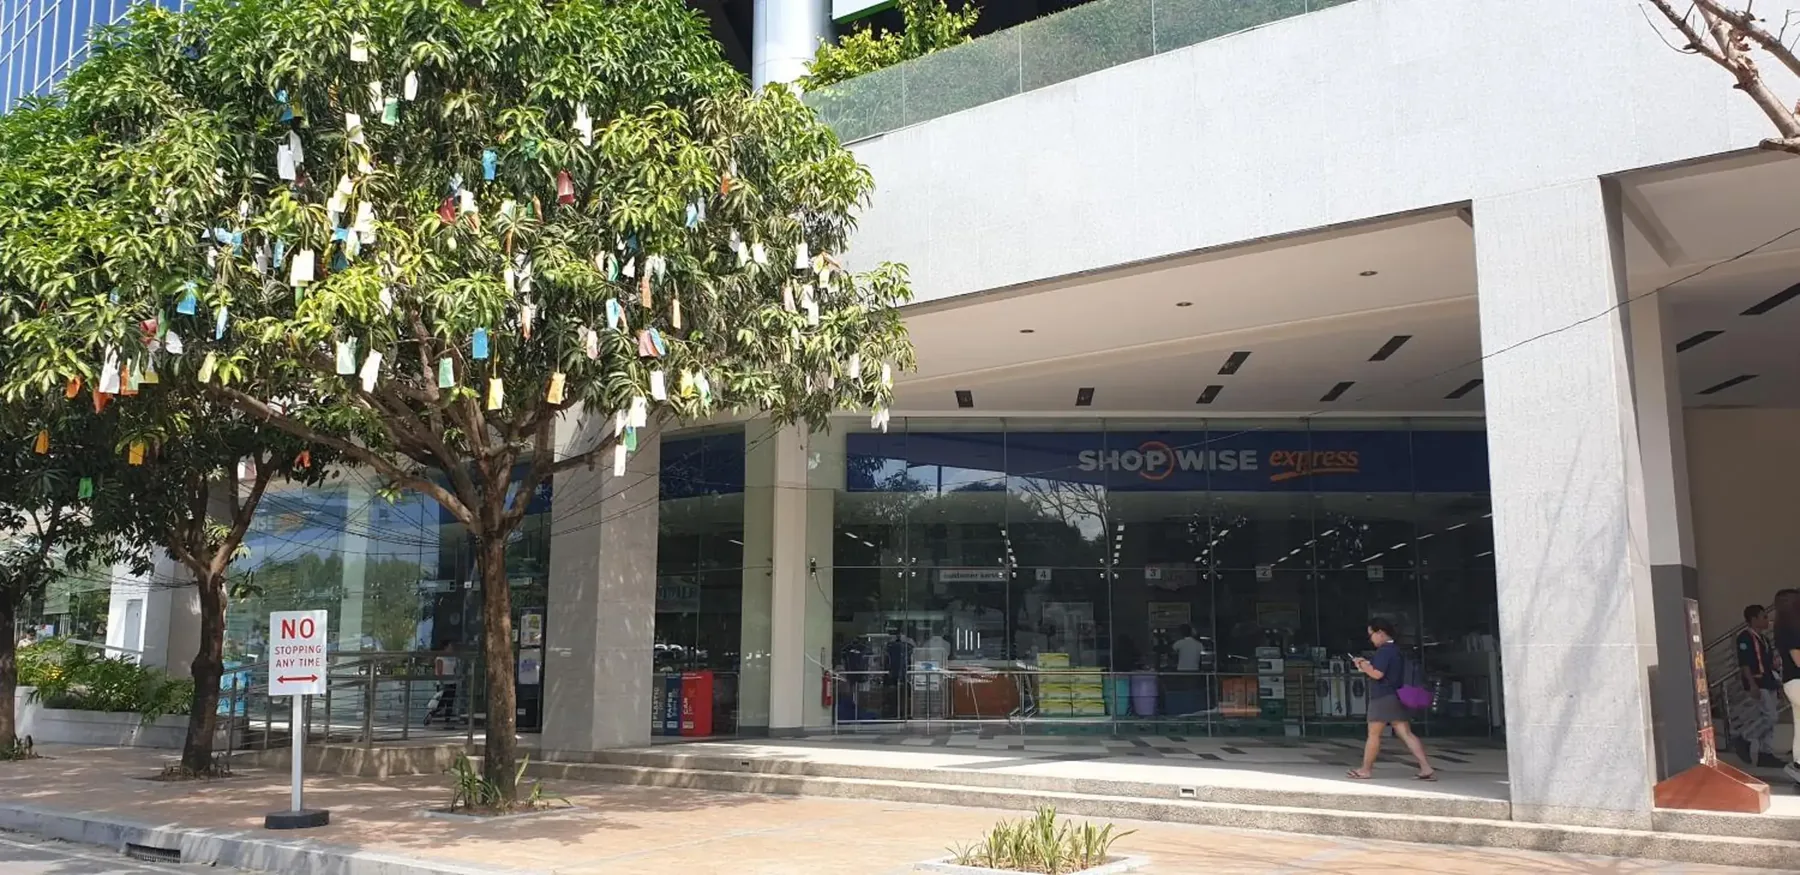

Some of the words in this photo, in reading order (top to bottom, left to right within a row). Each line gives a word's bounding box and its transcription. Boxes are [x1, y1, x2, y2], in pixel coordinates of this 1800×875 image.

[1268, 448, 1360, 471] express
[281, 618, 315, 639] NO
[274, 645, 322, 655] STOPPING
[275, 658, 295, 668] ANY
[299, 657, 321, 667] TIME
